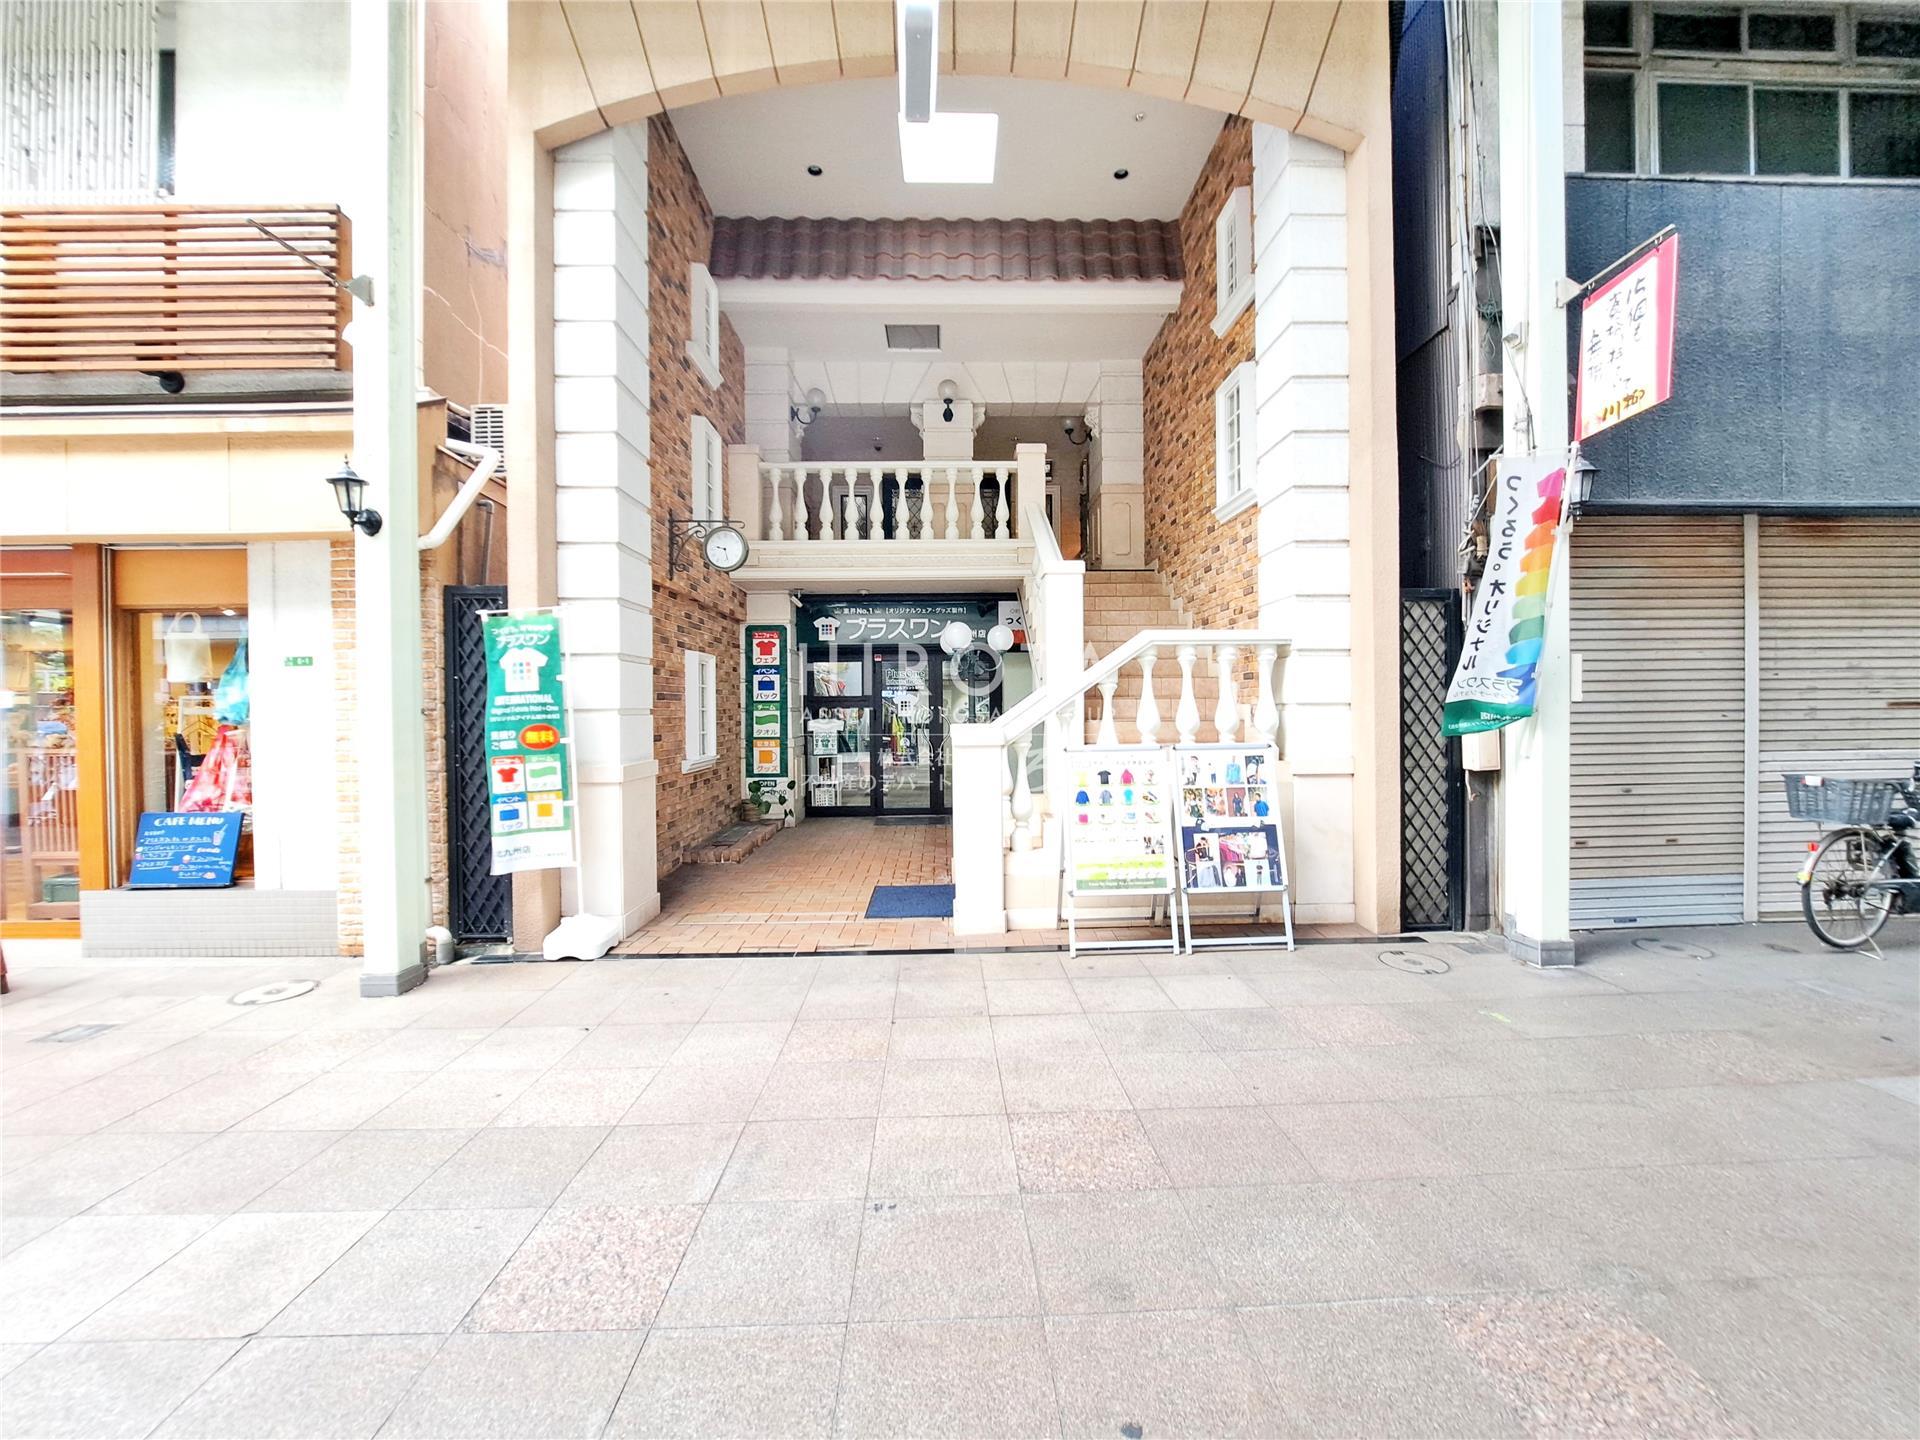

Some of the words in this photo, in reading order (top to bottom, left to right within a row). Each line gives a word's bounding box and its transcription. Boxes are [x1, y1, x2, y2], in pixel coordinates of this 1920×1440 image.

[846, 618, 951, 640] プラスワン
[525, 730, 555, 744] 無料
